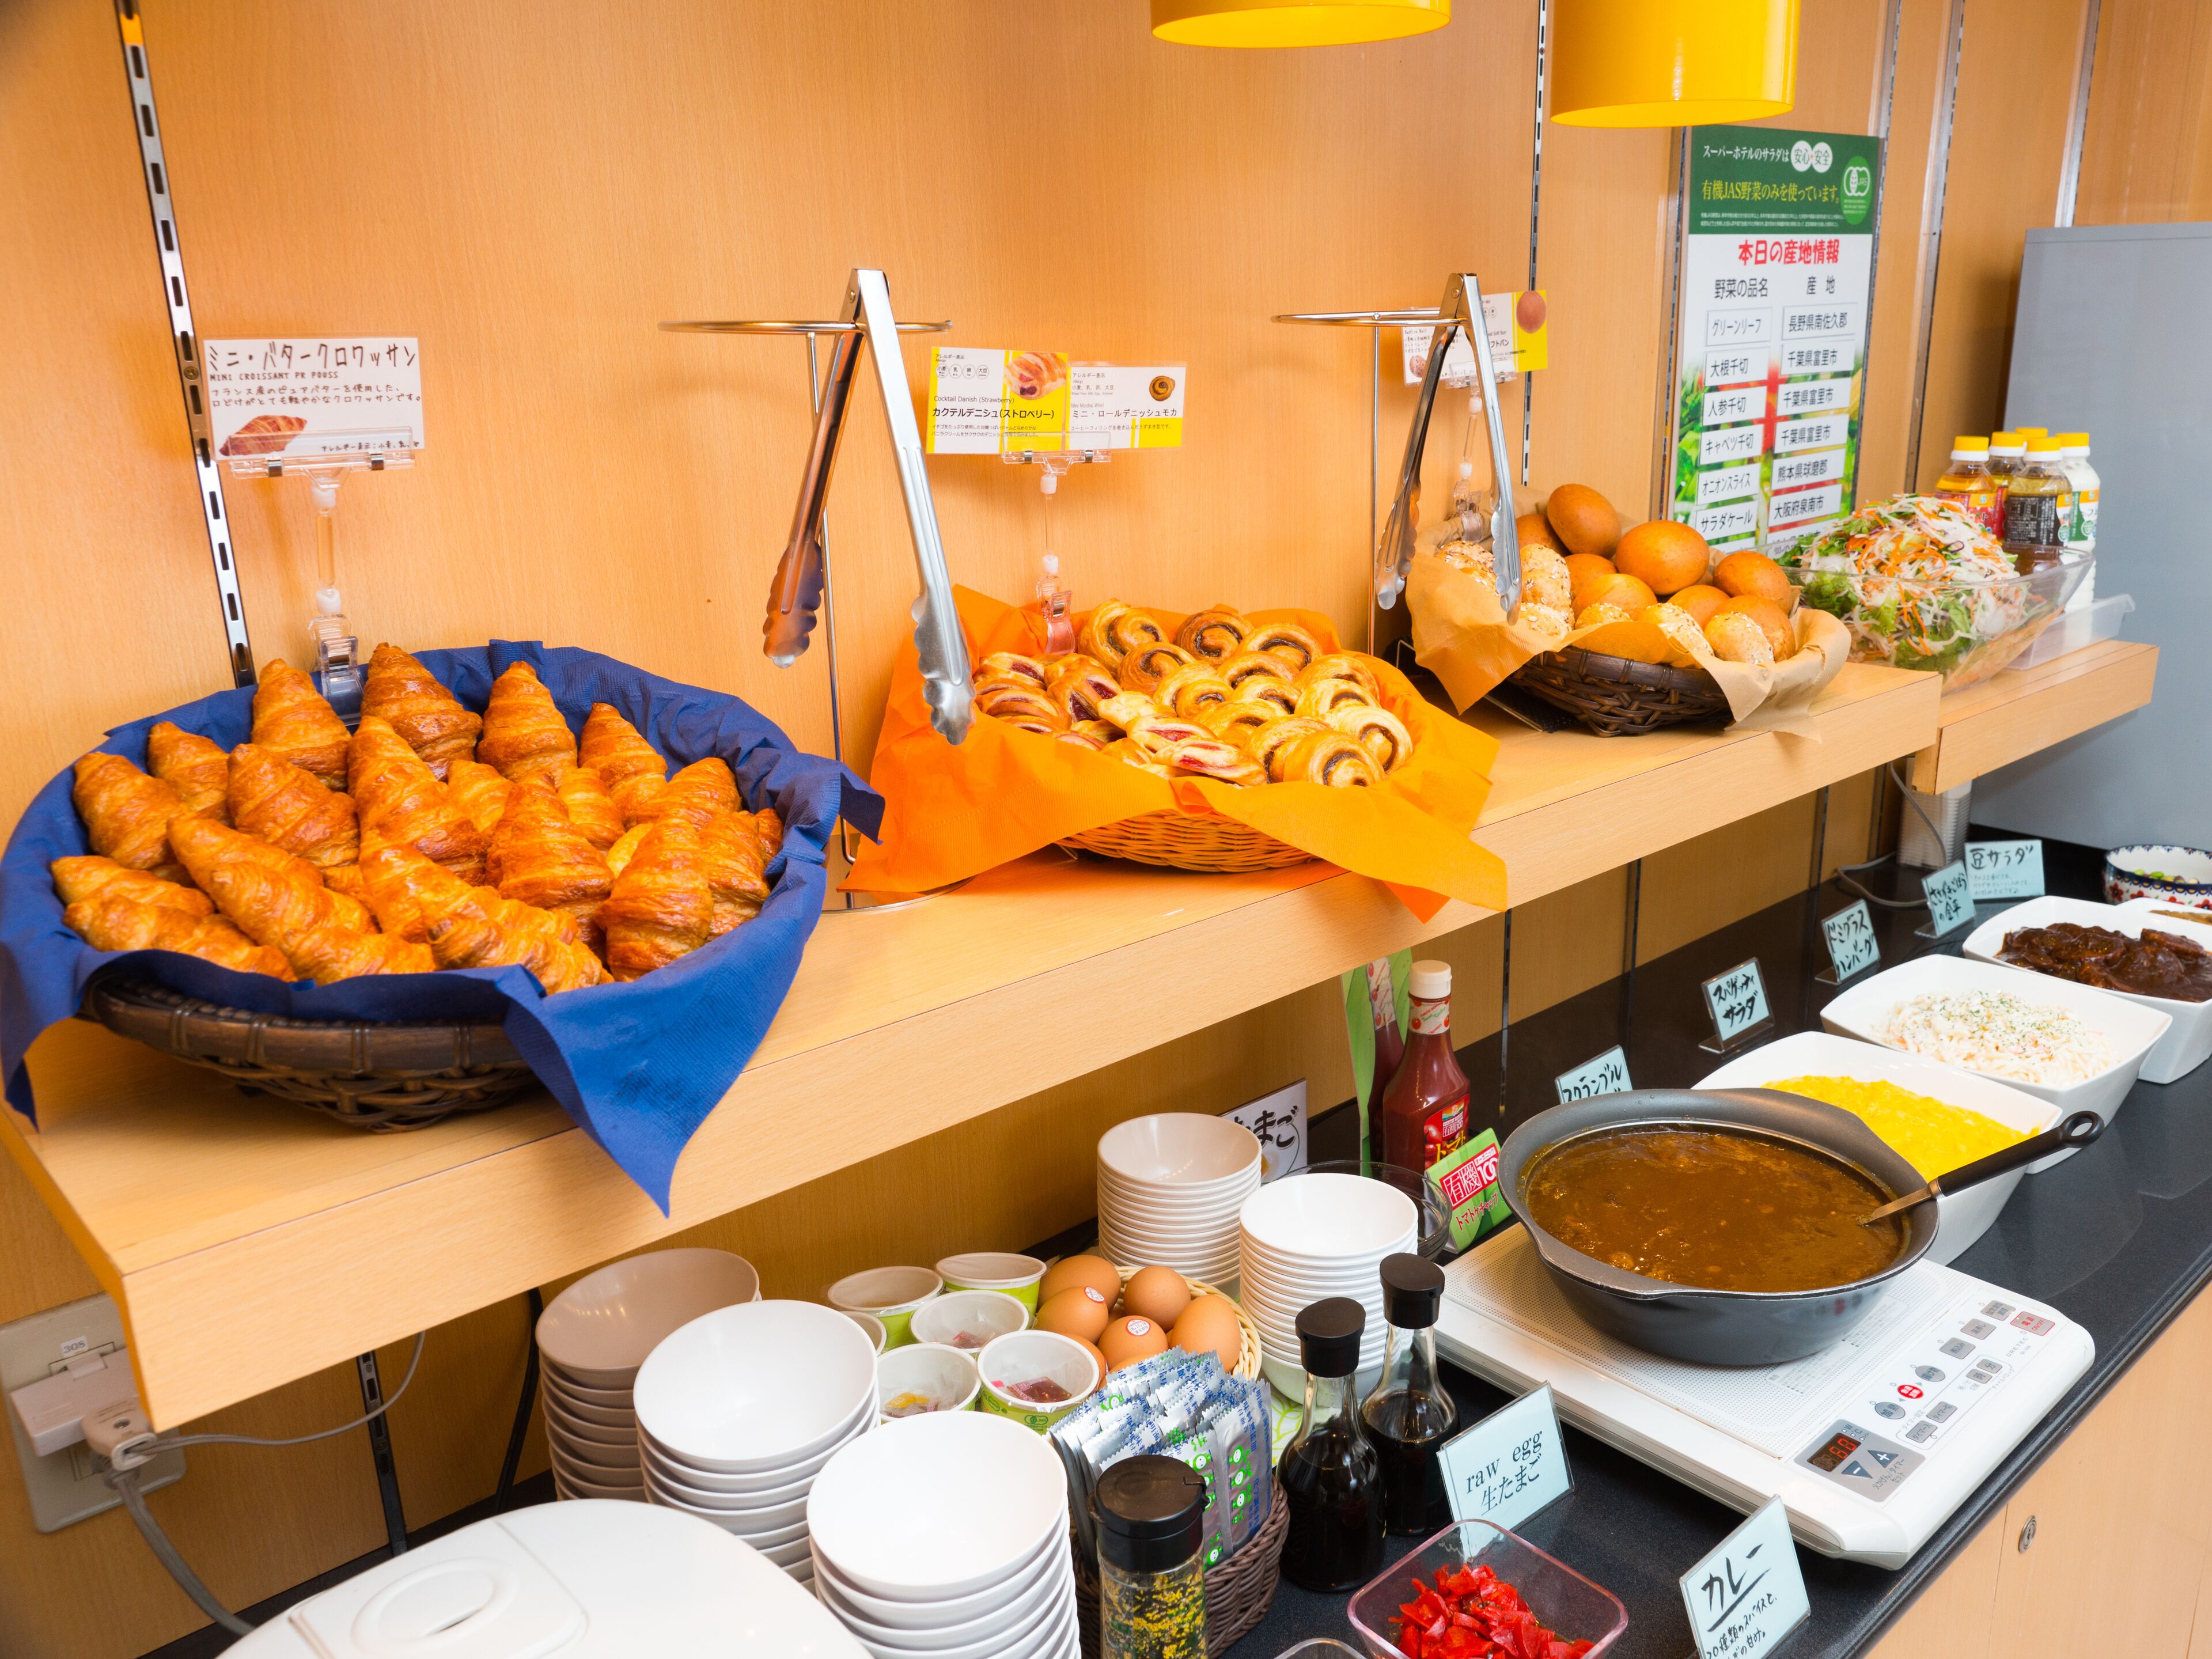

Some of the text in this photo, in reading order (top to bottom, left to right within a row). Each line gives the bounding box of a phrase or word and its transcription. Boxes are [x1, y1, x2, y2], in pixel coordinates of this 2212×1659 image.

[1702, 145, 1789, 162] スーパーホテルのサラダは
[1702, 179, 1839, 204] 有機JAS野菜のみを使っています。
[1738, 239, 1840, 266] 本日の産地情報
[1714, 278, 1768, 299] 野菜の品名
[1713, 312, 1847, 337] グリーンリーフ 長野県南佐久郡
[210, 341, 415, 371] ミニ・バタークロワッサン
[1490, 339, 1509, 348] フトパン
[1710, 349, 1838, 378] 大根千切 千葉県富里市
[1073, 408, 1177, 418] ミニ・ロールデニッシュモカ
[1708, 387, 1834, 417] 人参千切 千葉県富里市
[1706, 424, 1831, 455] キャベツ千切 千葉県富里市
[1703, 460, 1828, 496] オニオンスライス 熊本県球磨郡
[1701, 495, 1824, 533] サラダケール 大阪府泉南市
[1969, 845, 2033, 870] 豆サラダ
[1722, 990, 1758, 1027] サラダ
[1446, 1163, 1482, 1202] 有機
[1456, 1191, 1498, 1230] トマトケチャップ
[64, 1340, 85, 1353] 308
[2006, 1337, 2028, 1357] DRETEC
[1466, 1431, 1543, 1494] raw egg
[1481, 1453, 1541, 1516] 生たまご
[1701, 1543, 1763, 1612] カレー
